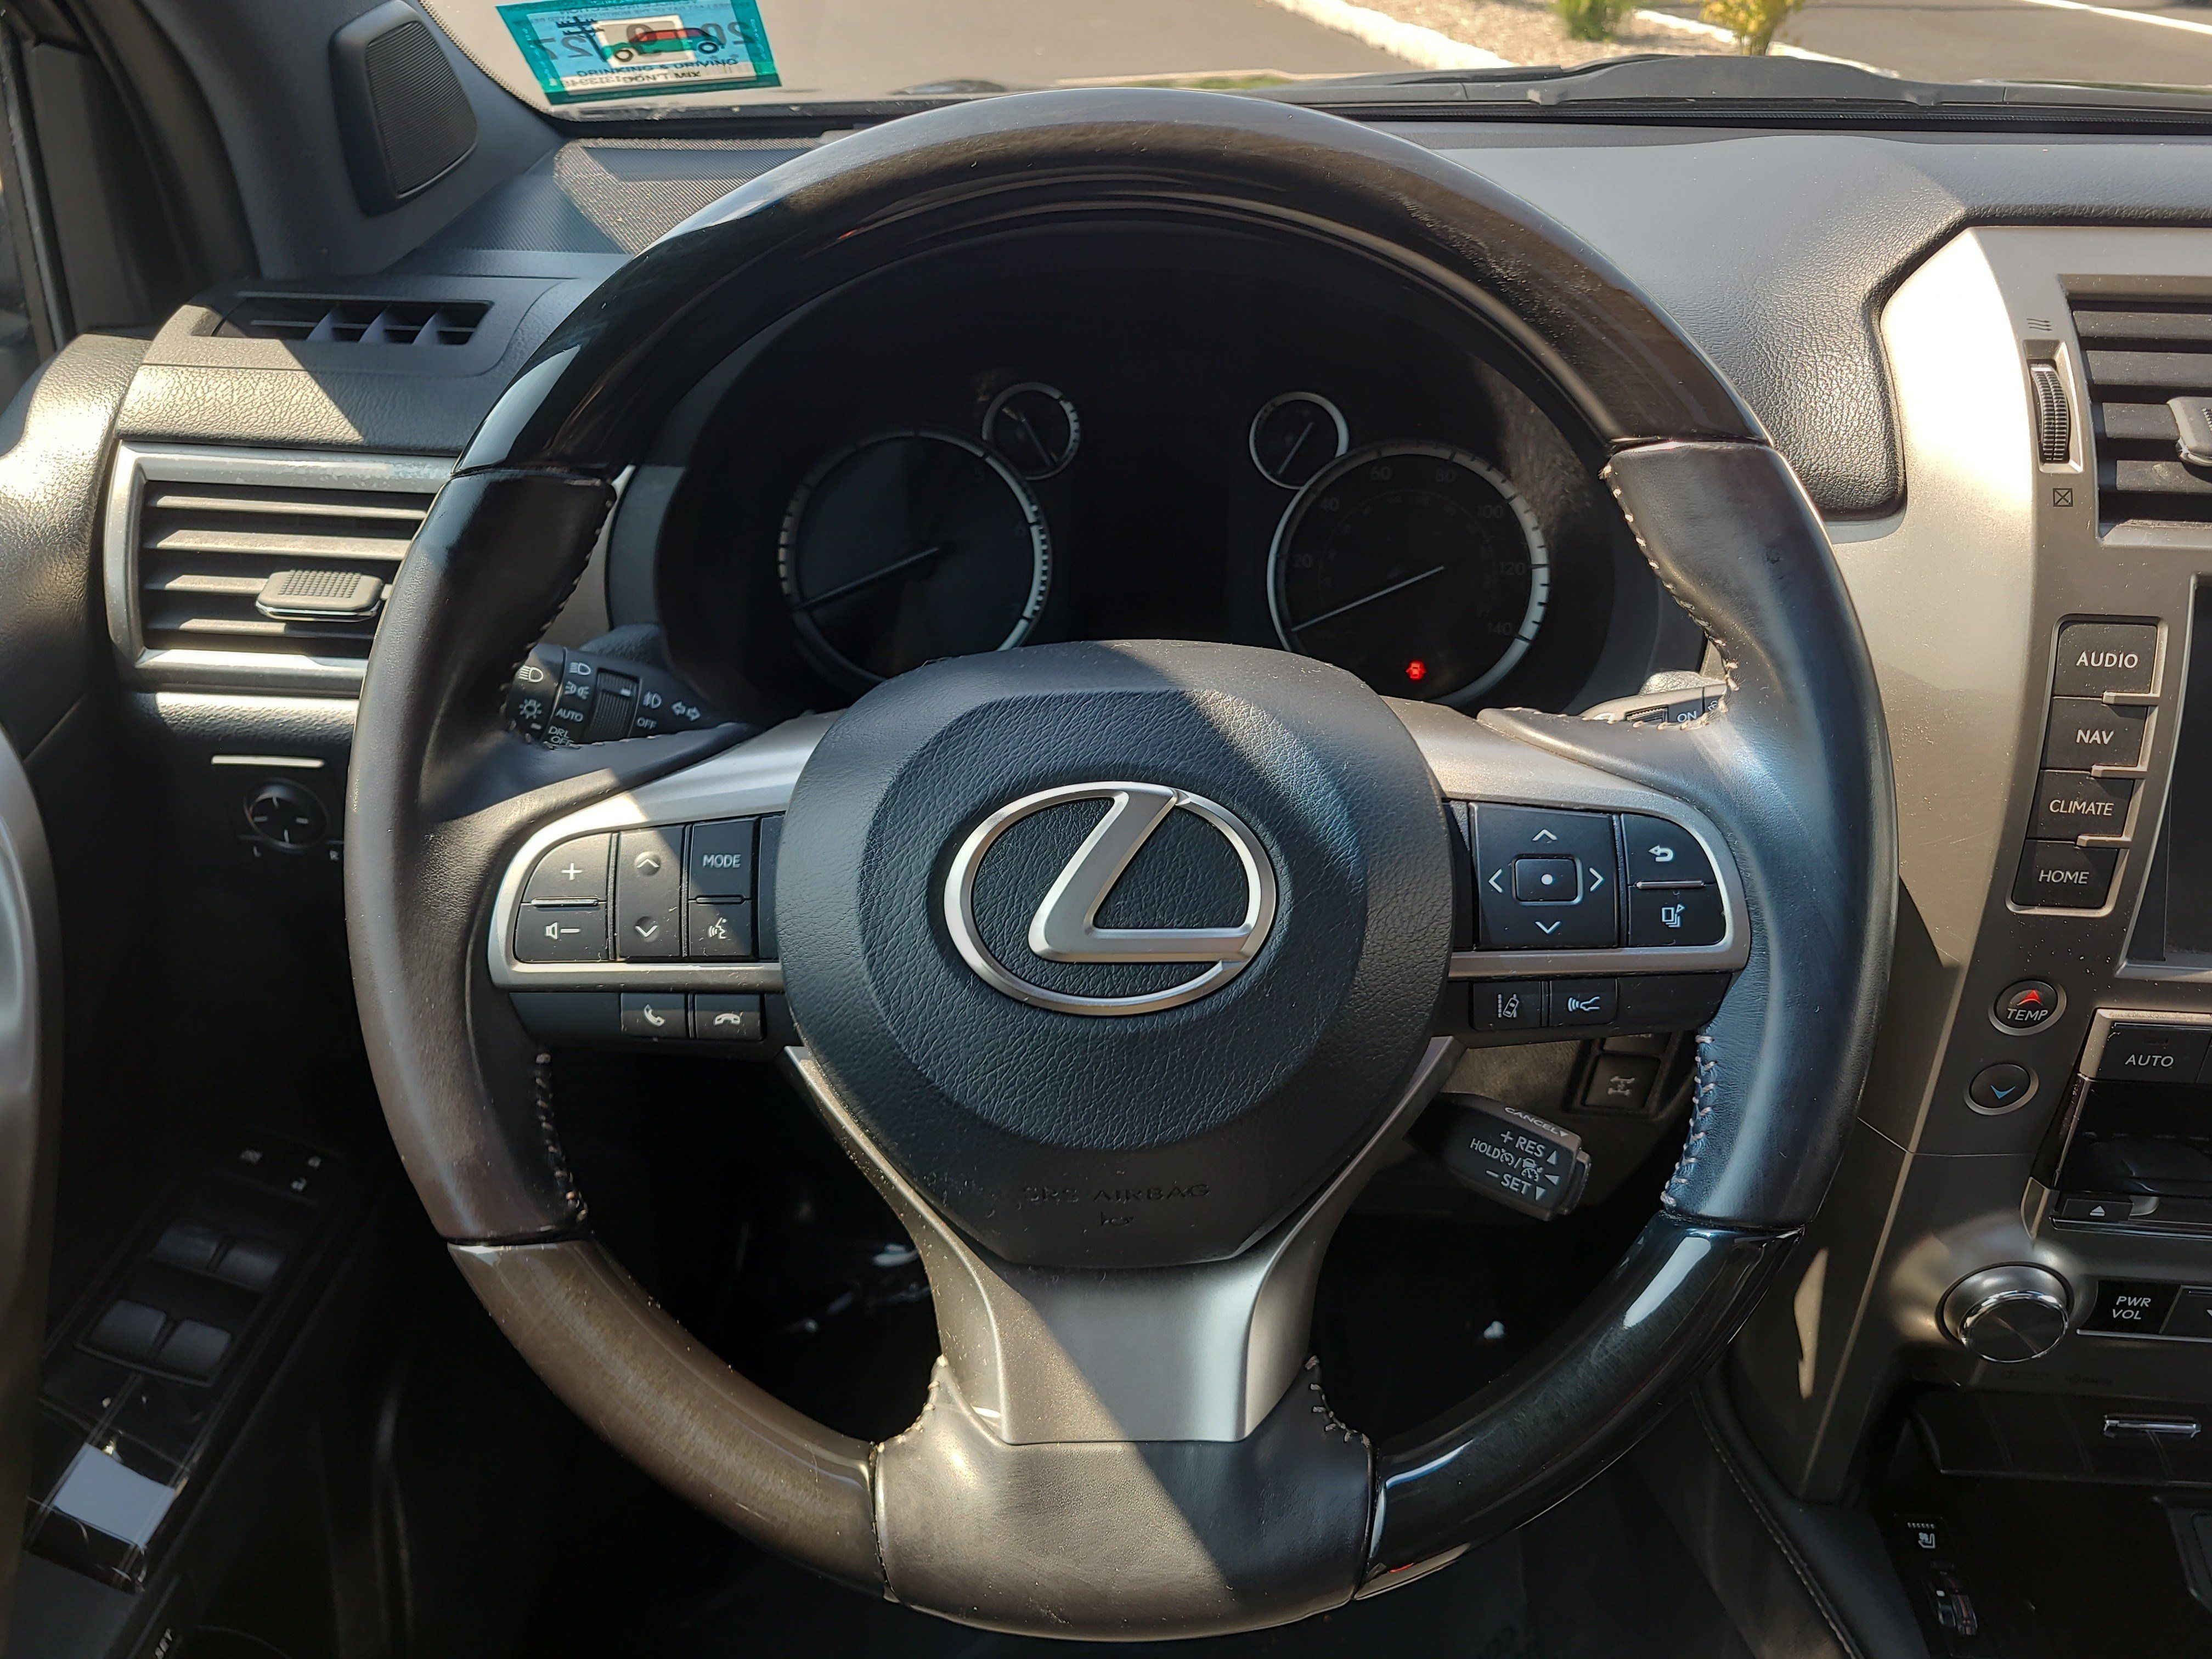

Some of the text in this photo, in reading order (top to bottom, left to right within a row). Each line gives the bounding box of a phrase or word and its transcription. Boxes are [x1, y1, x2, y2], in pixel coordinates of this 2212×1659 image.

[674, 69, 702, 80] MIX
[2075, 651, 2138, 670] AUDIO
[556, 708, 583, 723] AUTO
[1677, 710, 1697, 723] ON
[637, 716, 657, 730] OFF
[549, 726, 568, 737] DRL
[2076, 729, 2114, 745] NAV
[551, 735, 574, 746] OFF
[2049, 799, 2114, 816] CLIMATE
[703, 854, 742, 868] MODE
[2038, 870, 2089, 884] HOME
[2007, 1008, 2049, 1022] TEMP
[2125, 1053, 2174, 1068] AUTO
[1504, 1107, 1559, 1134] CANCEL
[1470, 1137, 1502, 1160] HOLD
[1514, 1136, 1545, 1158] RES
[1500, 1174, 1532, 1196] SET
[1093, 1183, 1211, 1203] AIRBAG
[2115, 1295, 2152, 1308] PWR
[2112, 1308, 2142, 1321] VOL
